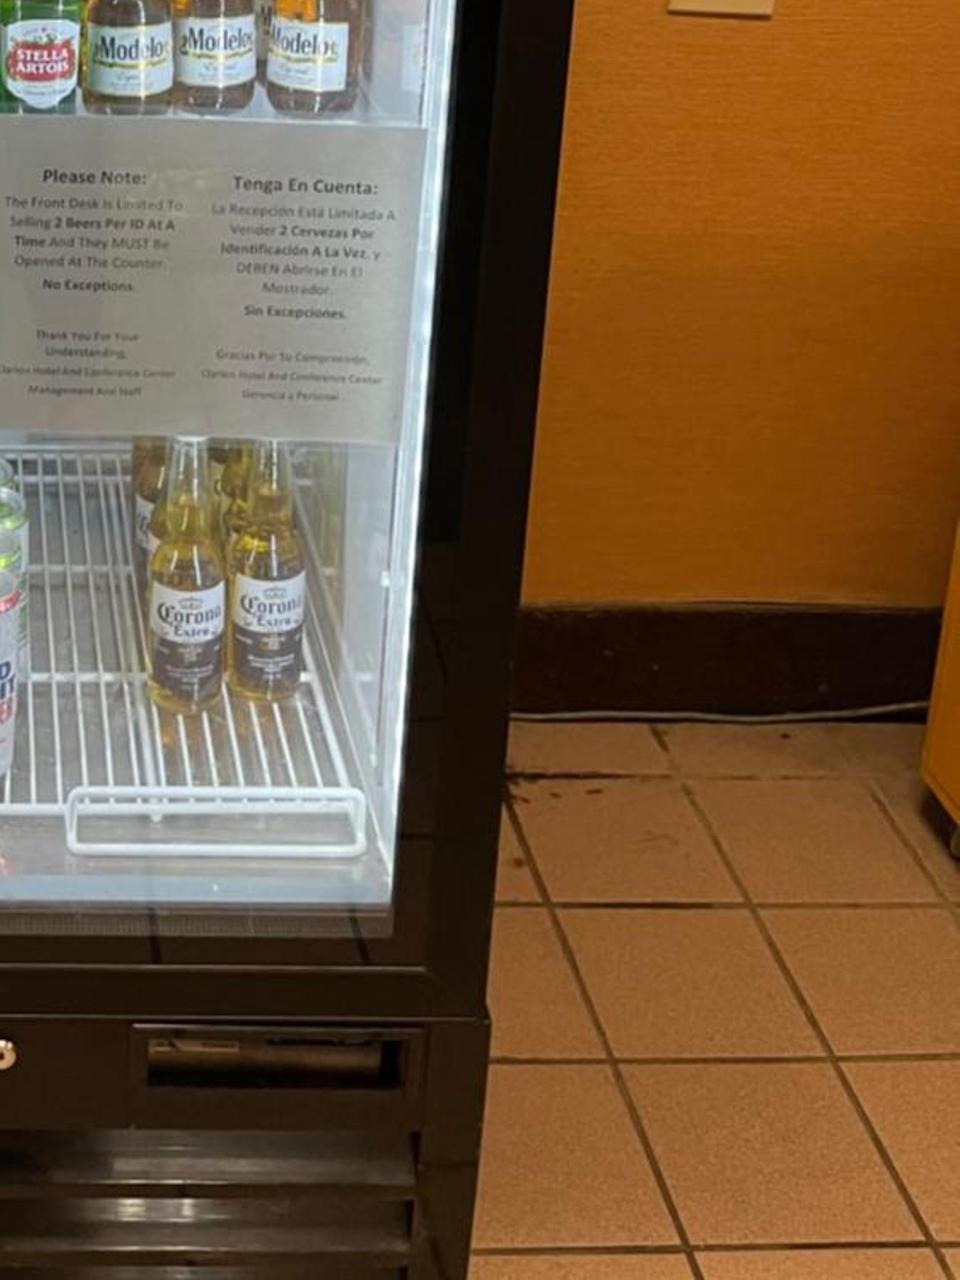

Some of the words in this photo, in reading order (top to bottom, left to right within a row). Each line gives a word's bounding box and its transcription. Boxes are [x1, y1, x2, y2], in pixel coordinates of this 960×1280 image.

[16, 47, 69, 62] STELLA
[15, 61, 70, 75] ARTOIS
[42, 169, 95, 185] Please
[101, 170, 147, 185] Note:
[233, 175, 283, 195] Tenga
[288, 178, 308, 192] En
[313, 179, 378, 195] Cuenta:
[5, 196, 28, 208] The
[32, 196, 65, 209] Front
[69, 197, 99, 209] Desk
[117, 199, 163, 211] Limited
[167, 199, 183, 211] To
[211, 203, 226, 215] La
[328, 207, 383, 221] Limitada
[386, 209, 396, 220] A
[10, 216, 51, 230] Selling
[54, 218, 62, 229] 2
[66, 217, 102, 229] Beers
[105, 218, 126, 230] Per
[130, 219, 144, 230] ID
[147, 219, 162, 230] At
[165, 220, 176, 231] A
[230, 223, 276, 236] Vender
[279, 225, 288, 236] 2
[291, 225, 349, 239] Cervezas
[352, 227, 375, 239] Por
[15, 236, 46, 247] Time
[49, 236, 75, 248] And
[79, 237, 107, 251] They
[112, 237, 149, 250] MUST
[153, 238, 169, 249] Be
[311, 245, 321, 257] A
[325, 246, 339, 258] La
[14, 255, 65, 268] Opened
[68, 256, 82, 268] At
[86, 256, 109, 268] The
[236, 262, 279, 275] DEBEN
[332, 265, 348, 277] En
[42, 279, 62, 290] No
[243, 305, 263, 317] Sin
[36, 330, 68, 341] Thank
[72, 331, 91, 342] You
[94, 332, 111, 341] For
[240, 594, 301, 616] Corona
[157, 602, 222, 626] Corona
